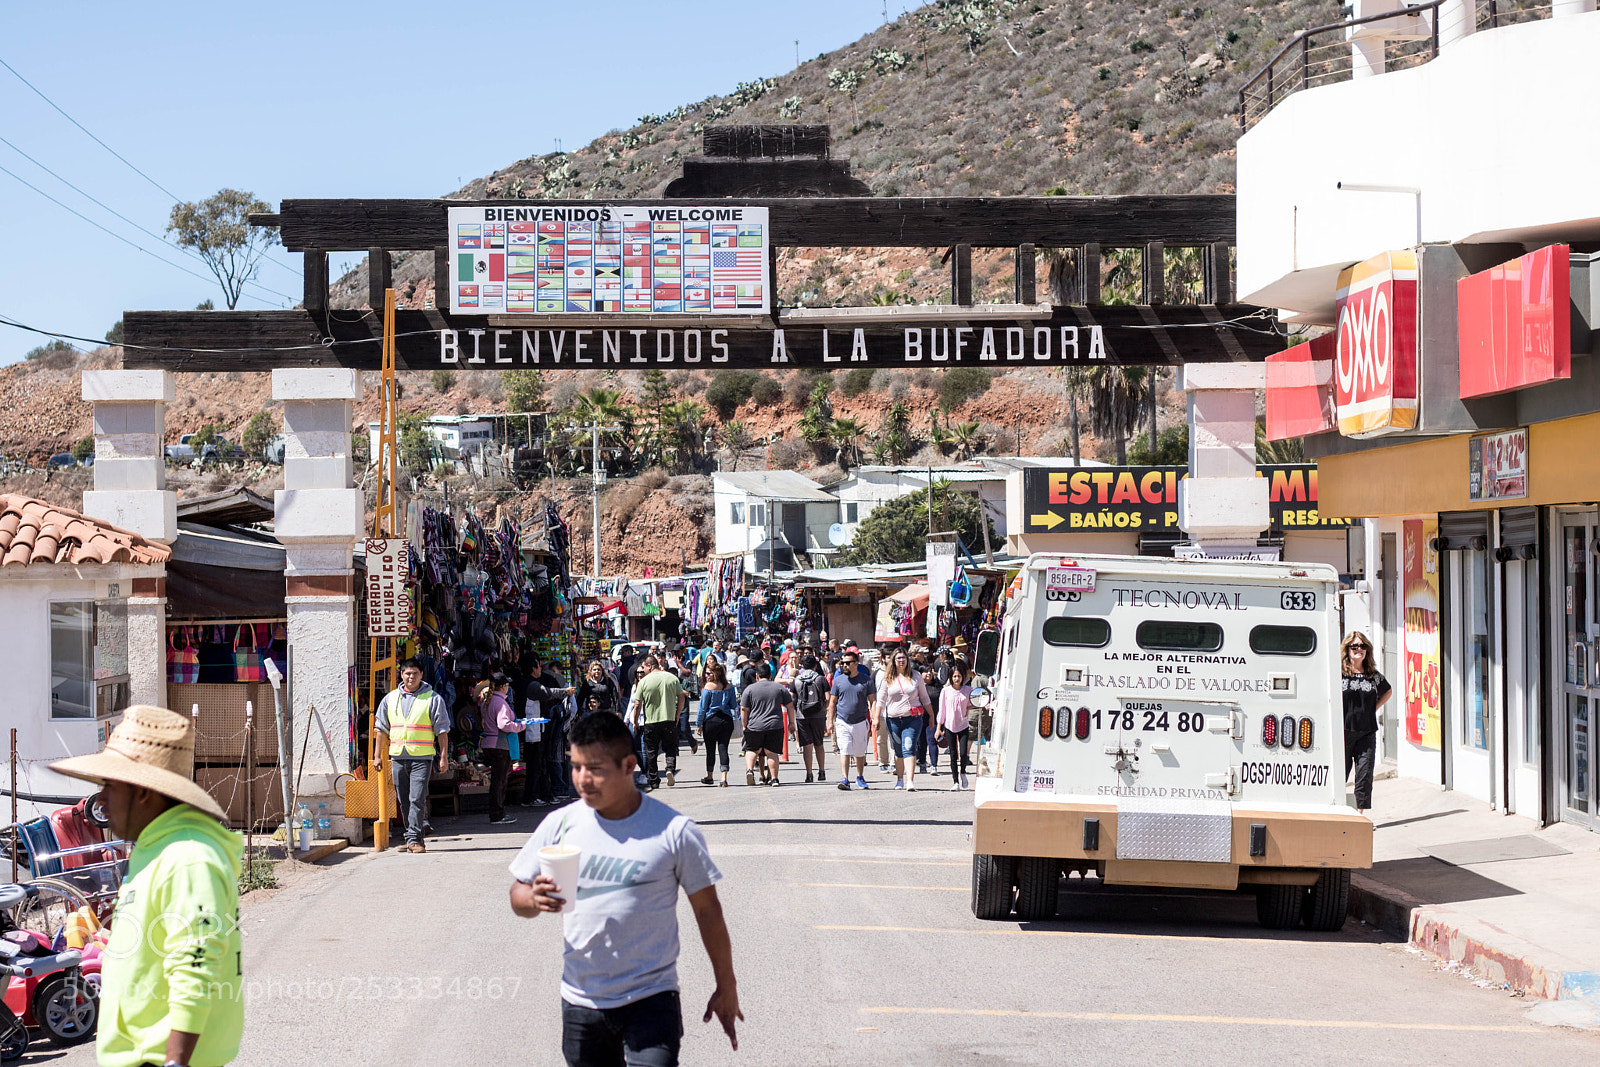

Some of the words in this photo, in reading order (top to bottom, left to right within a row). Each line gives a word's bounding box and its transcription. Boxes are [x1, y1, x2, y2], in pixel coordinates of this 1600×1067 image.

[483, 208, 612, 222] BIENVENIDOS
[648, 209, 743, 222] WELCOME
[440, 328, 729, 363] BIENVENIDOS
[770, 328, 788, 362] A
[822, 328, 868, 362] LA
[904, 325, 1106, 361] BUFADORA
[1337, 286, 1390, 404] OXXO
[1070, 507, 1142, 528] BAÑOS
[369, 574, 382, 633] CERRADO
[1111, 588, 1248, 611] TECNOVAL
[1282, 591, 1315, 610] 633
[1104, 652, 1119, 661] LA
[1122, 653, 1163, 662] MEJOR
[1166, 654, 1247, 665] ALTERNATIVA
[1156, 665, 1173, 674] EN
[1176, 666, 1191, 674] EL
[1083, 674, 1171, 690] TRASLADO
[1175, 677, 1196, 691] DE
[1201, 678, 1272, 693] VALORES
[1125, 702, 1163, 711] QUEJAS
[1142, 711, 1170, 731] 24
[1177, 712, 1205, 733] 80
[1033, 776, 1054, 785] 2018
[1241, 762, 1329, 787] DGSP/008-97/207
[1097, 785, 1168, 797] SEGURIDAD
[1171, 787, 1225, 800] PRIVADA
[580, 855, 647, 886] NIKE
